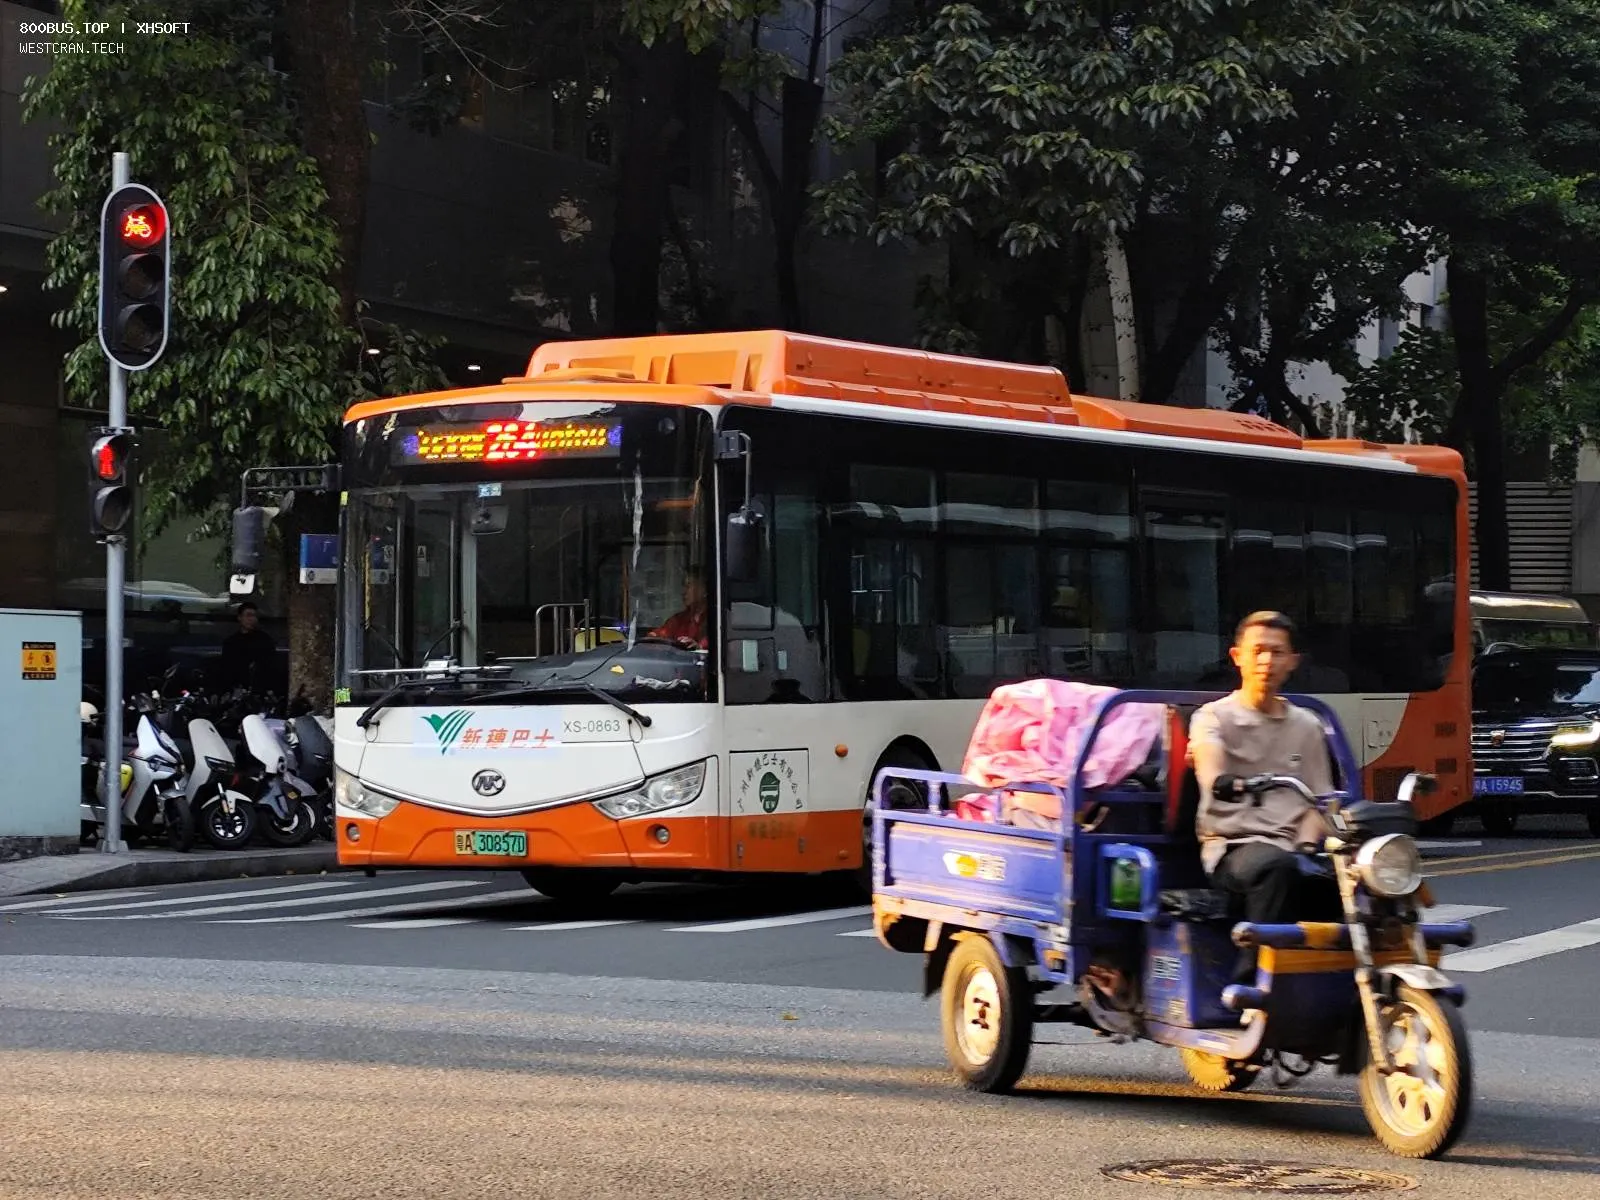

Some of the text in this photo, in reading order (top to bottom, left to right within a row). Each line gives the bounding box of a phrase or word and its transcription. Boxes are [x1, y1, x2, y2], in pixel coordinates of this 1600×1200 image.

[563, 720, 621, 733] XS-0863
[461, 727, 555, 749] 新穗巴士
